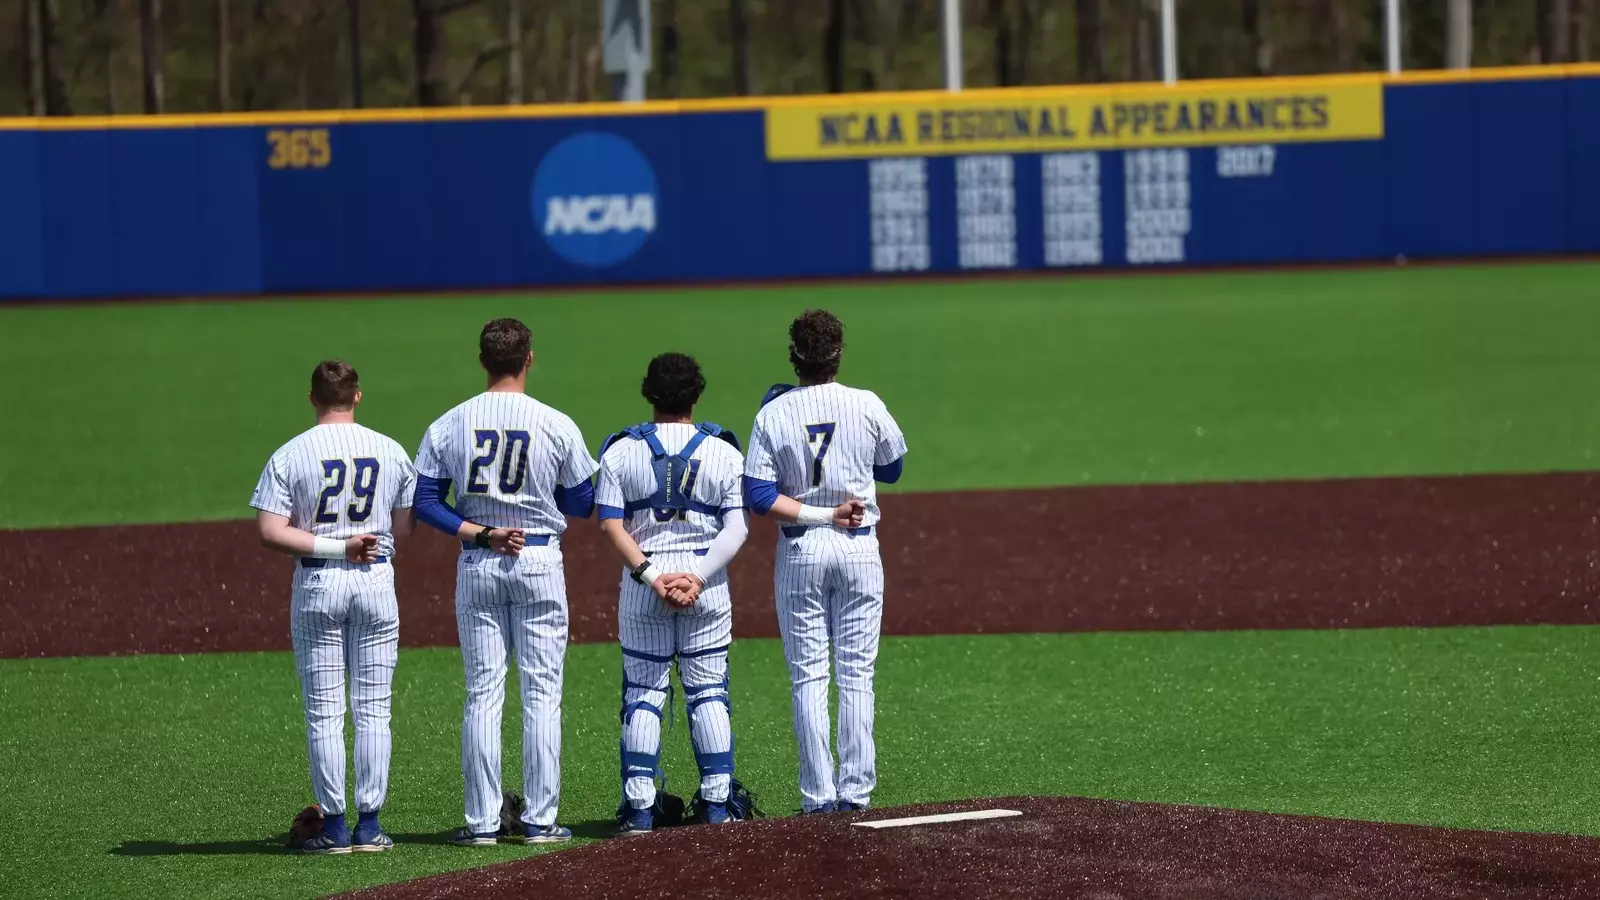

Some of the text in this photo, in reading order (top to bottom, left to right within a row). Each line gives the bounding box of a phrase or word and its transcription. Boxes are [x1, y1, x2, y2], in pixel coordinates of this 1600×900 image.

[818, 96, 1330, 147] NCAA REGIONAL APPEARANCES
[266, 129, 332, 169] 365
[1217, 145, 1276, 177] 2017
[543, 193, 656, 236] NCAA
[466, 428, 532, 496] 20
[804, 420, 837, 487] 7
[315, 456, 381, 524] 29
